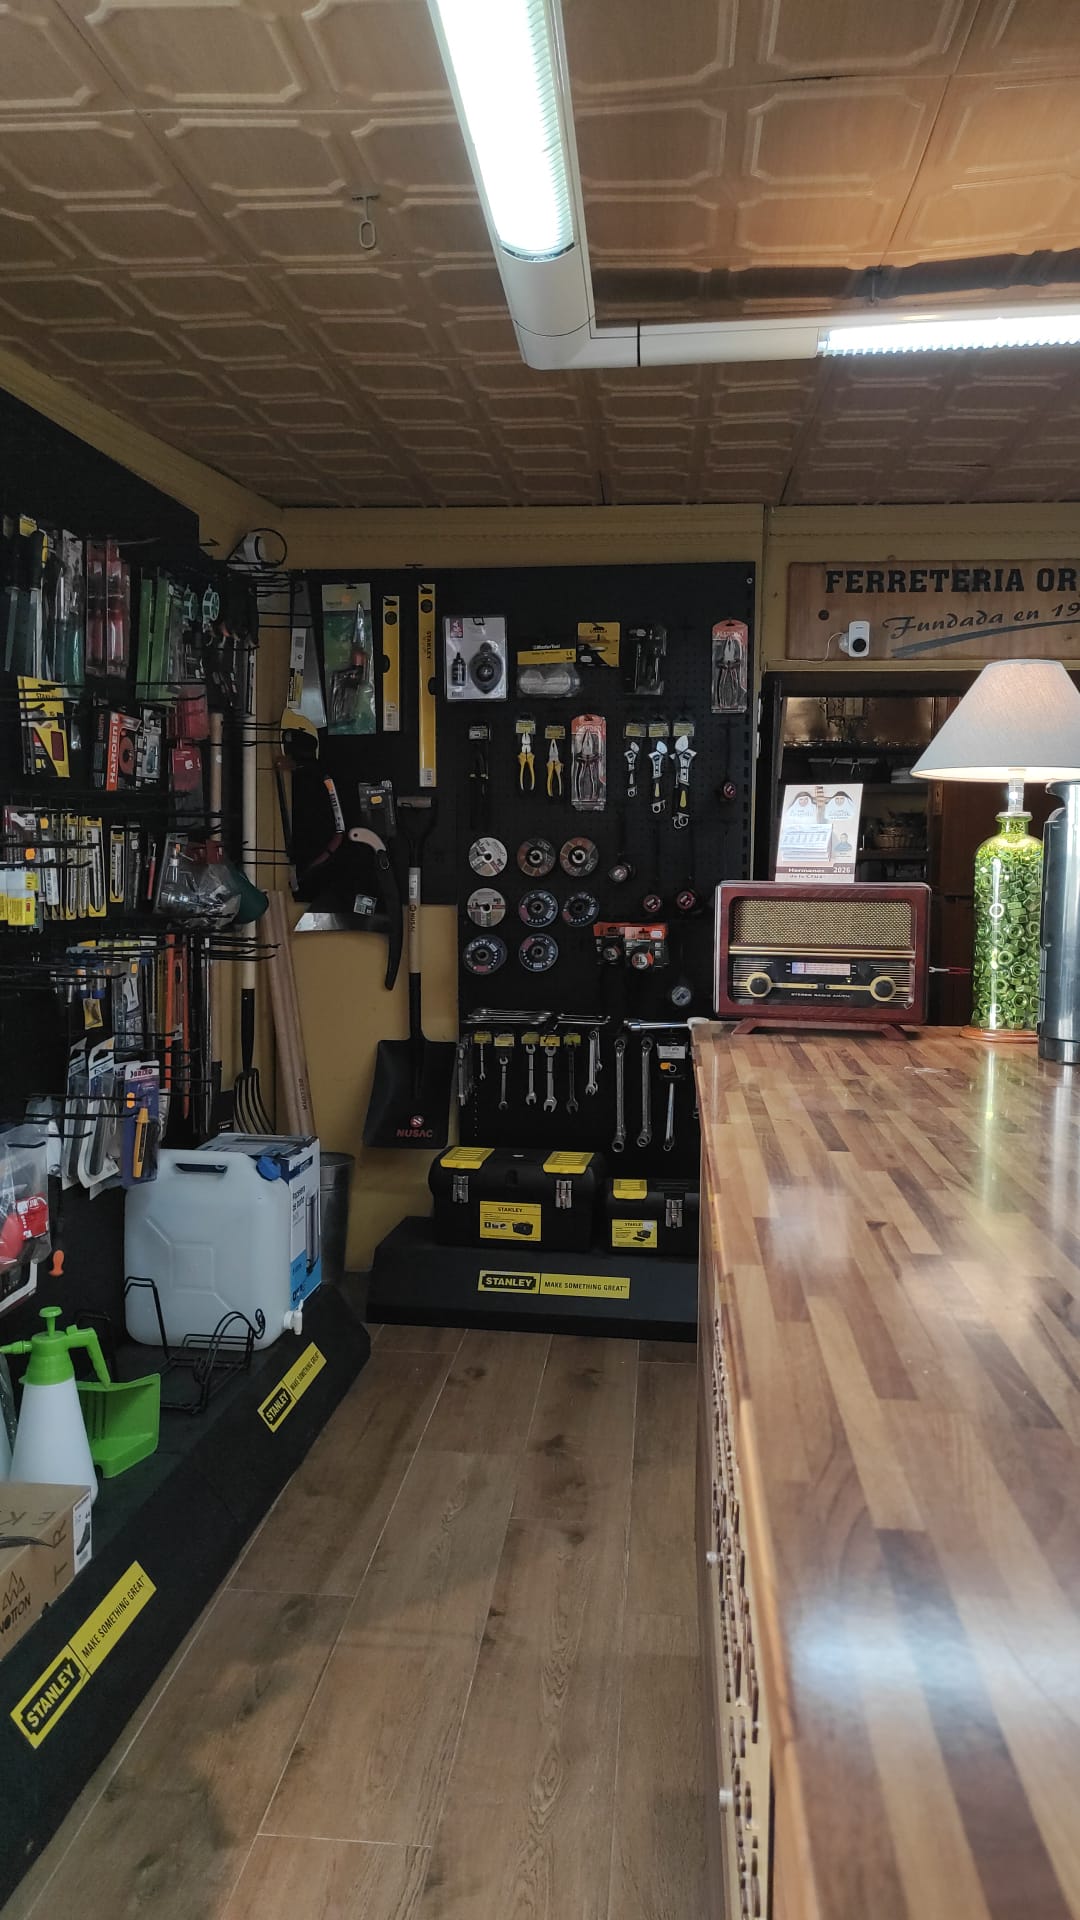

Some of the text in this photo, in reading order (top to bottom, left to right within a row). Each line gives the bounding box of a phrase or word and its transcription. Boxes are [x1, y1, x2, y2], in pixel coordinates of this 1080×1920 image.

[825, 568, 1025, 593] FERRETERIA
[882, 609, 1004, 640] Fundada
[1013, 608, 1040, 622] en
[110, 726, 118, 783] HARDEN
[396, 1129, 433, 1138] NUSAC
[485, 1277, 625, 1292] STANLEY MAKE SOMETHING GREAT
[266, 1391, 289, 1421] STANLEY
[27, 1577, 146, 1727] STANLEY MAKE SOMETHING GREAT
